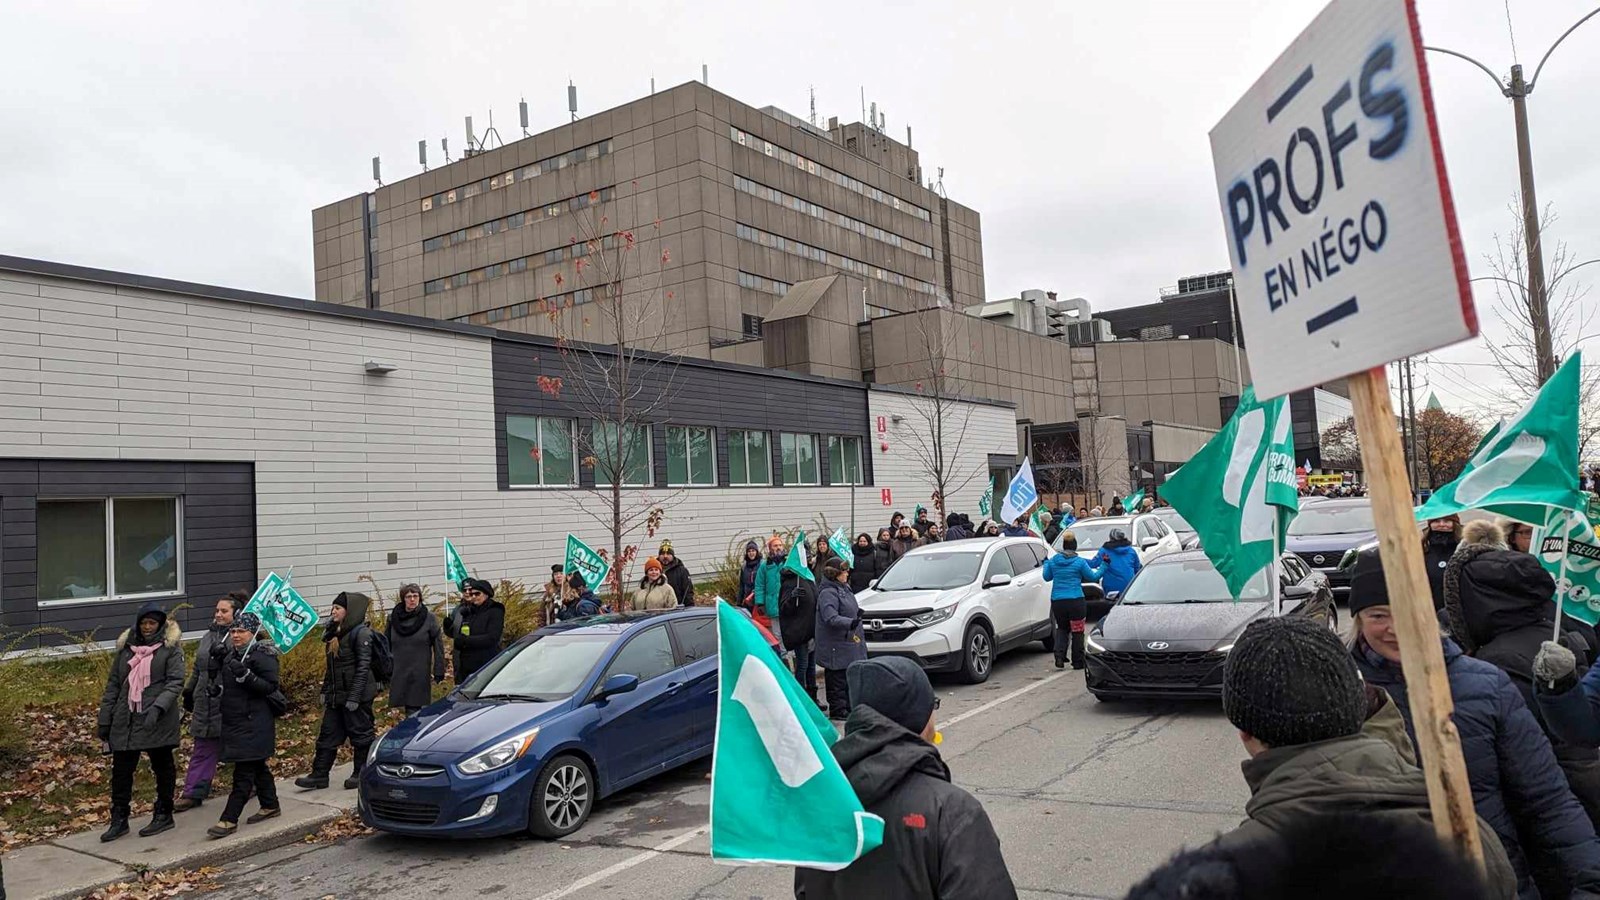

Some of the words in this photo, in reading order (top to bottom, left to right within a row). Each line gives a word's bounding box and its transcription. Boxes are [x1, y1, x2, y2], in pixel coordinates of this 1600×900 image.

[1226, 40, 1409, 268] PROFS
[1264, 257, 1299, 313] EN
[1300, 199, 1388, 289] NÉGO
[1543, 539, 1571, 551] D'UN
[1571, 543, 1600, 559] SEUL
